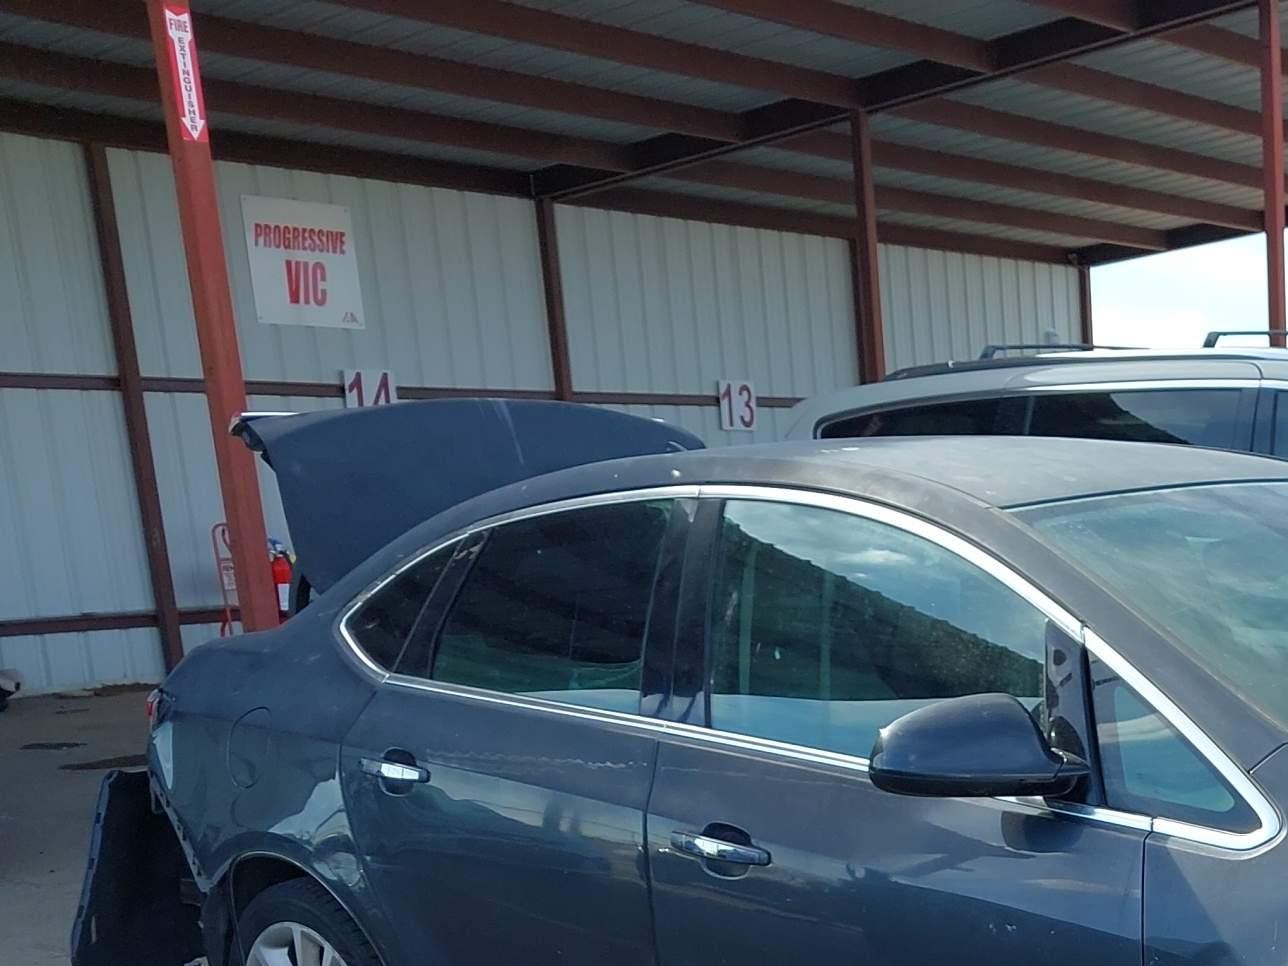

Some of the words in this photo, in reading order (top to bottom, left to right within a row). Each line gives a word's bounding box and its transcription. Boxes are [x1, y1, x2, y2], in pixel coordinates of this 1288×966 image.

[168, 18, 189, 33] FIRE
[178, 37, 198, 132] EXTINGUISHER
[254, 222, 347, 256] PROGRESSIVE
[285, 259, 327, 307] VIC
[720, 383, 755, 428] 13
